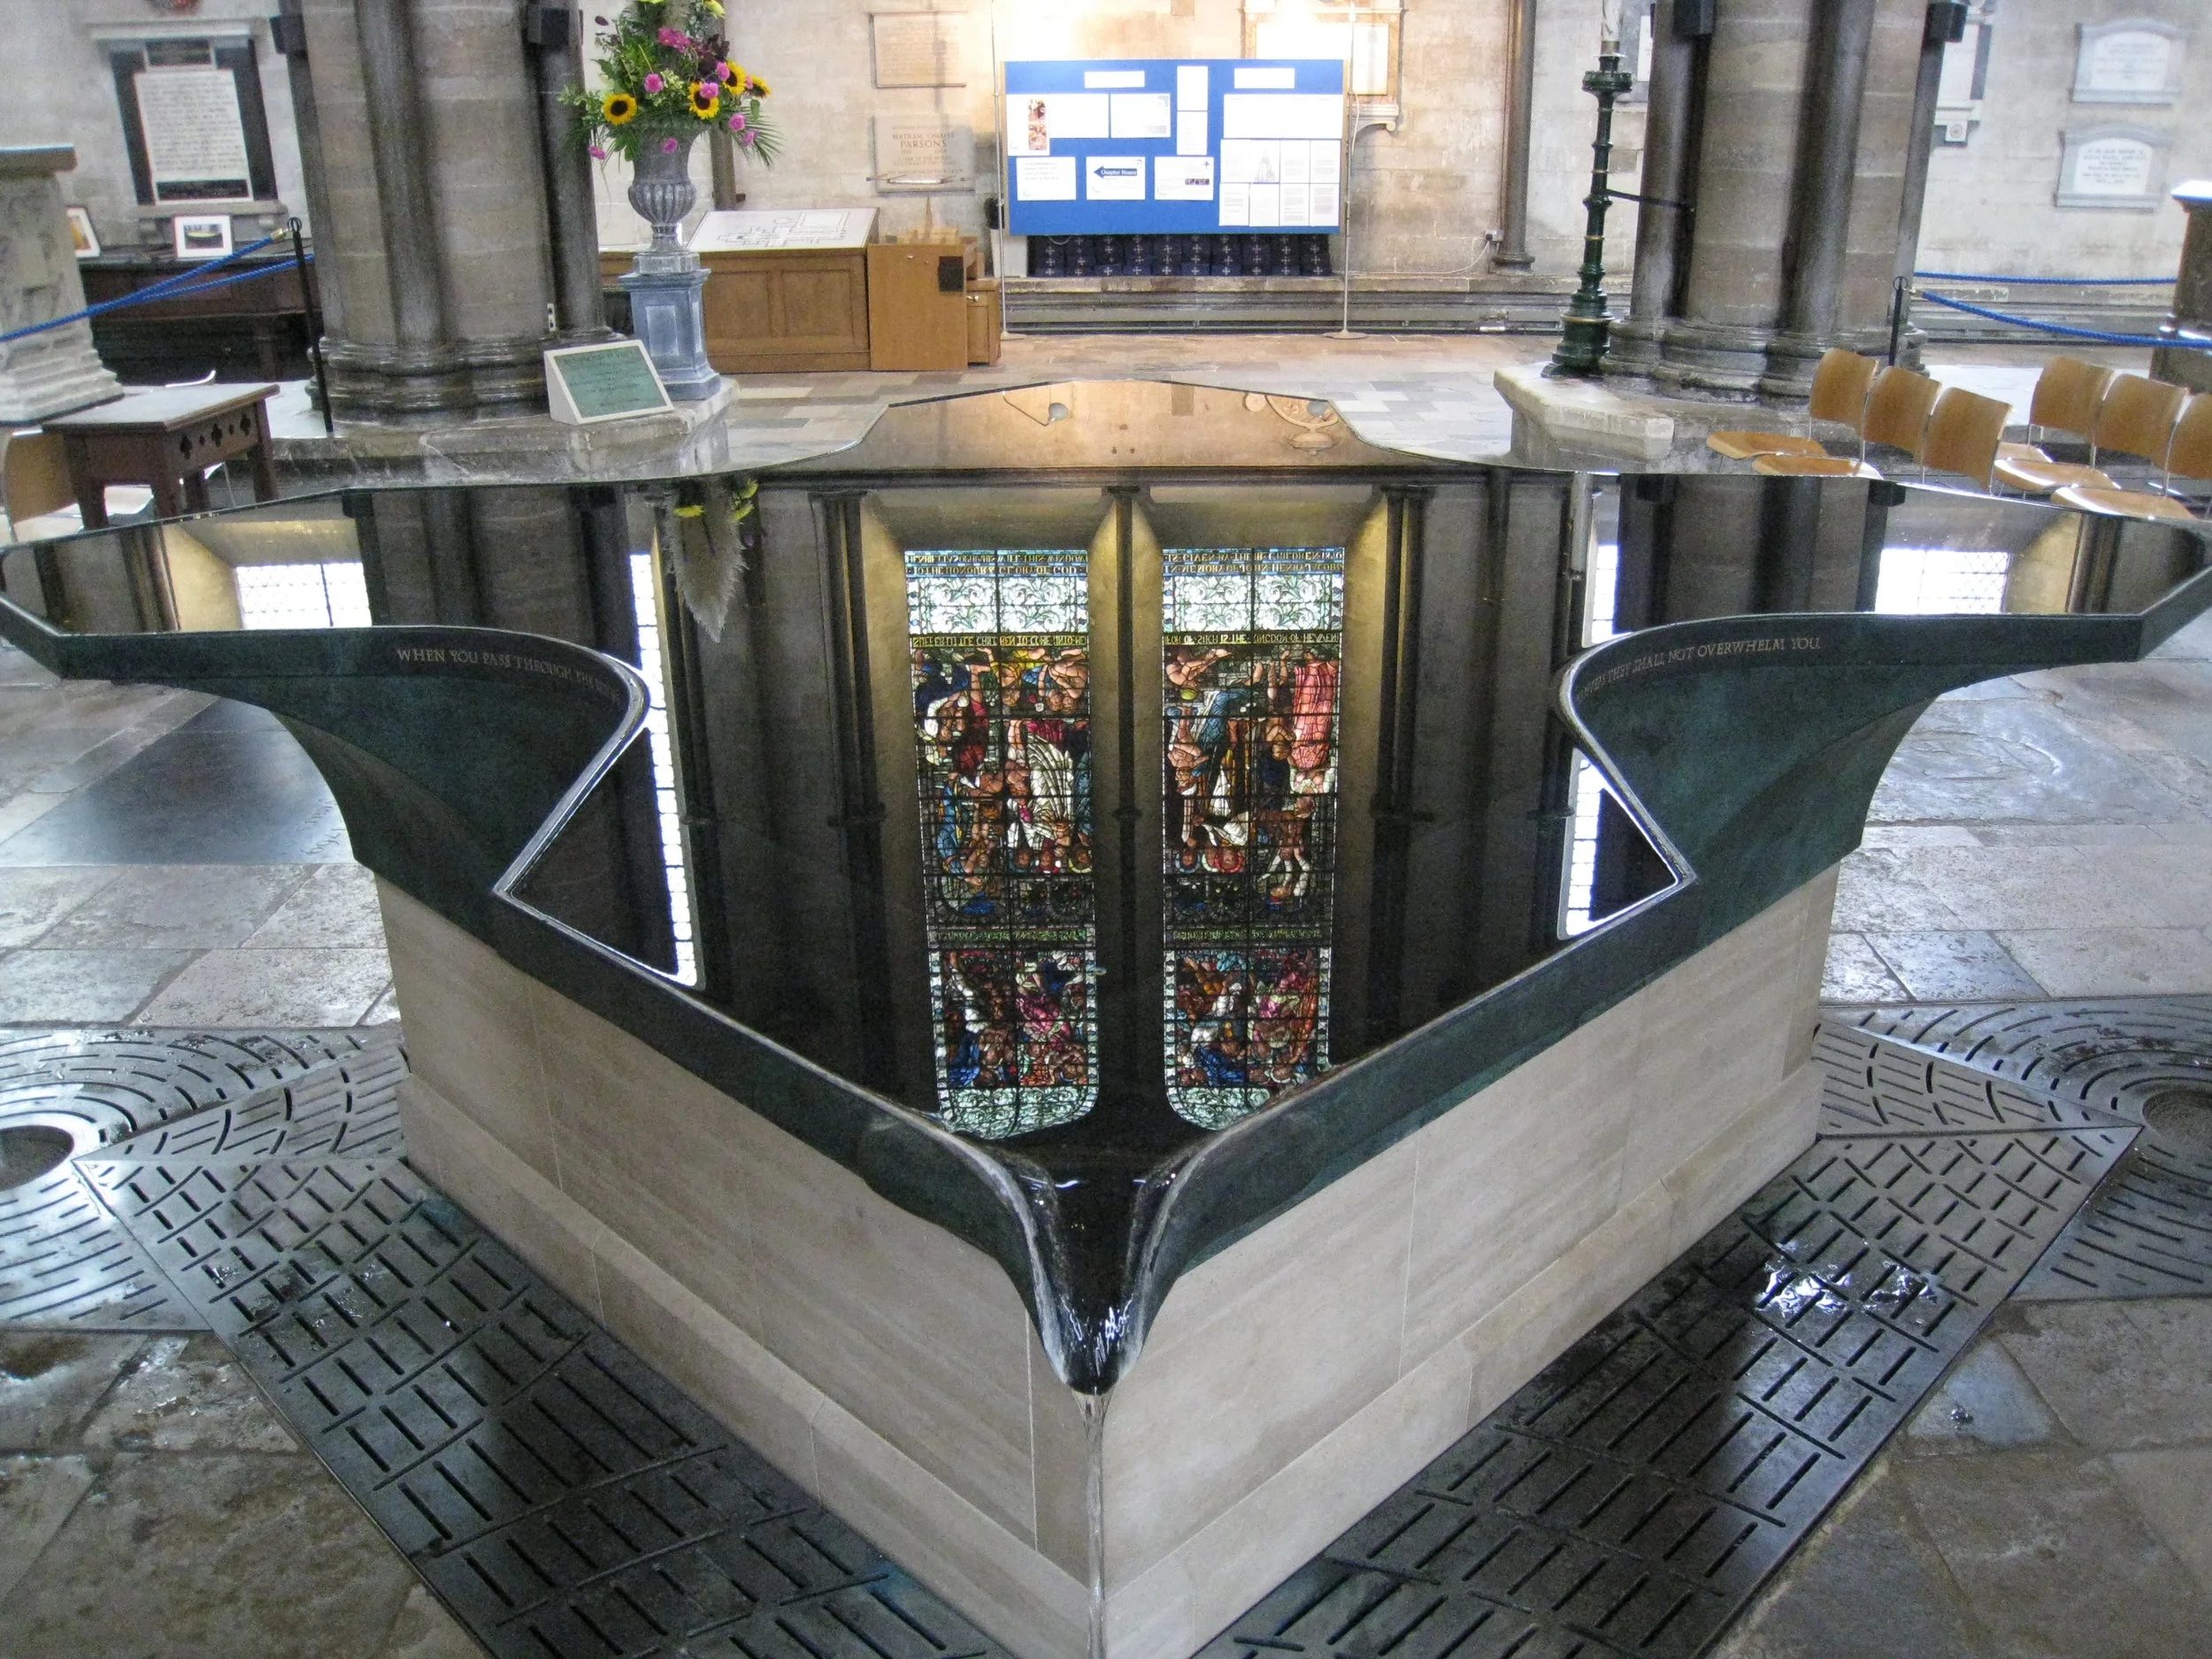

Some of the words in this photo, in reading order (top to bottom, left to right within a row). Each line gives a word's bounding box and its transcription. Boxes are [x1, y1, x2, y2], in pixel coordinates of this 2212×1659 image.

[901, 140, 947, 149] PARSONS
[397, 648, 446, 662] WHEN
[449, 649, 478, 664] YOU
[482, 652, 511, 667] PASS
[1632, 653, 1665, 674] SHALL
[1667, 646, 1695, 664] NOT
[1697, 638, 1785, 657] OVERWHELM
[1791, 637, 1821, 650] YOU.
